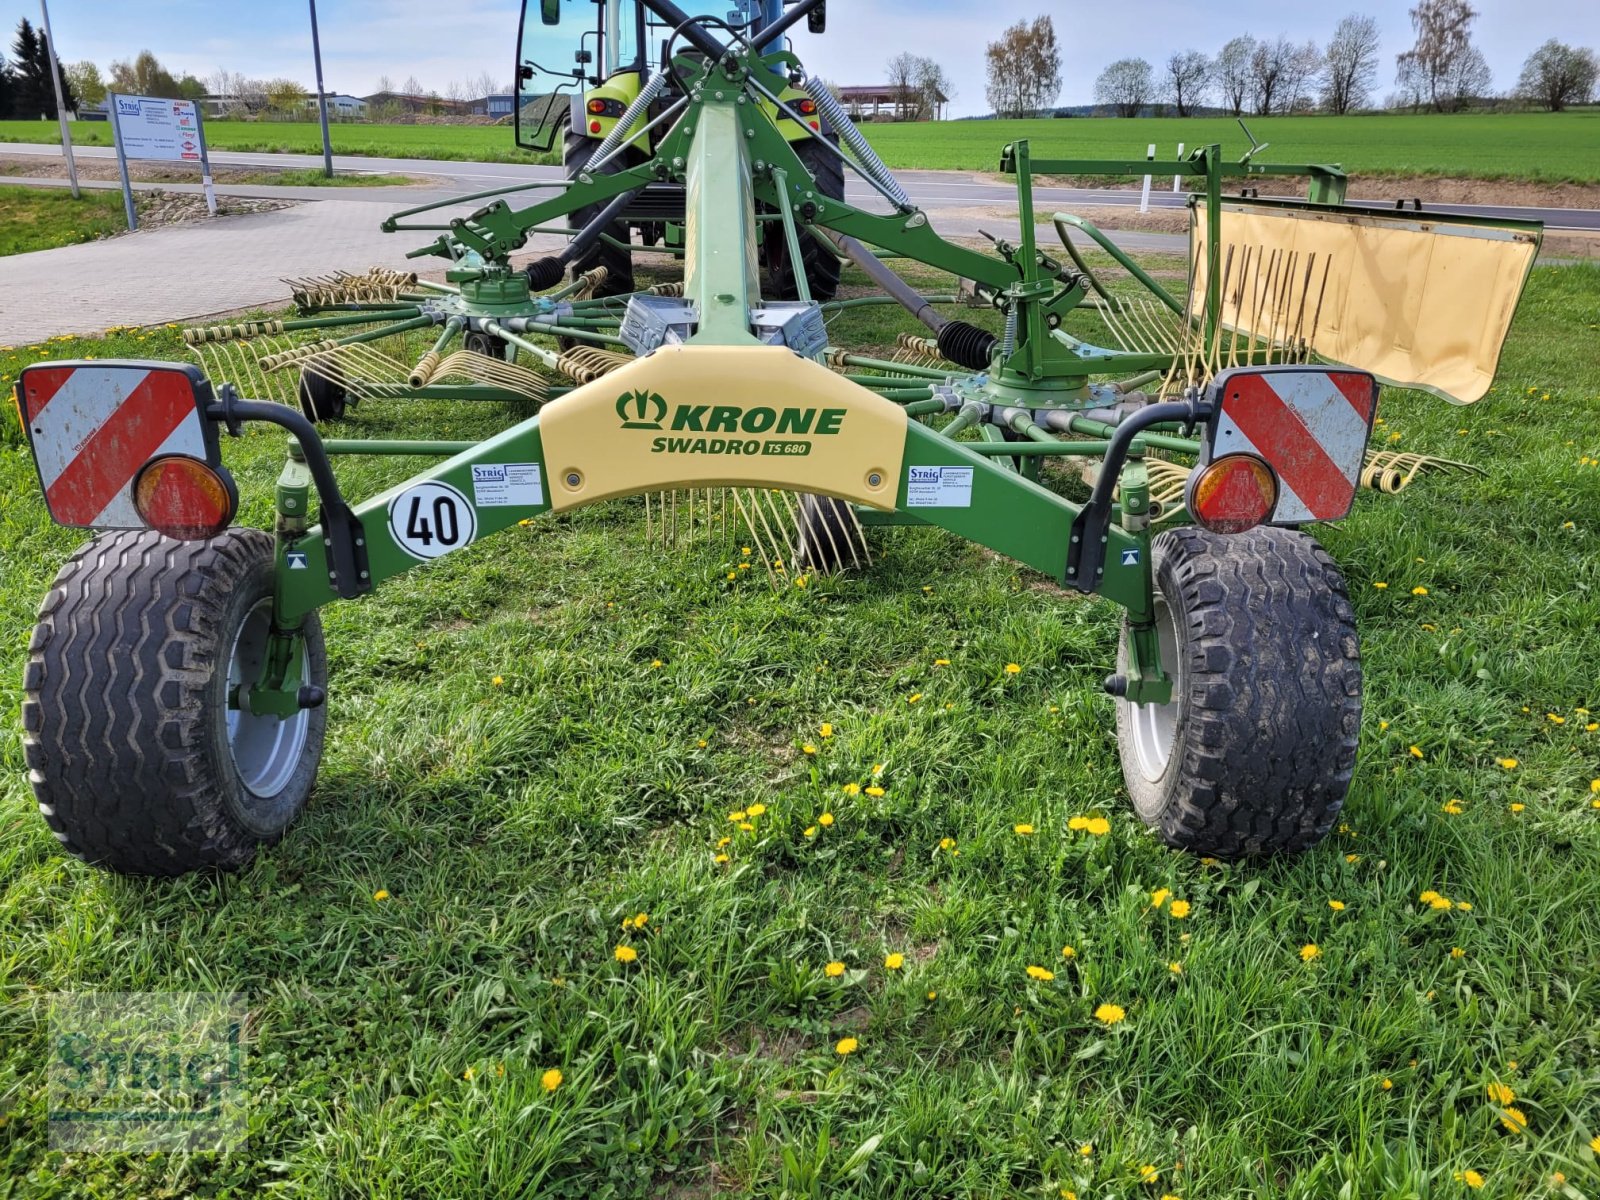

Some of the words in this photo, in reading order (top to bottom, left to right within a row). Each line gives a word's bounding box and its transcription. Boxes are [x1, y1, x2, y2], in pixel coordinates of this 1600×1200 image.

[671, 404, 848, 434] KRONE
[651, 437, 761, 456] SWADRO
[768, 443, 783, 454] TS
[784, 443, 807, 455] 680
[406, 495, 459, 546] 40
